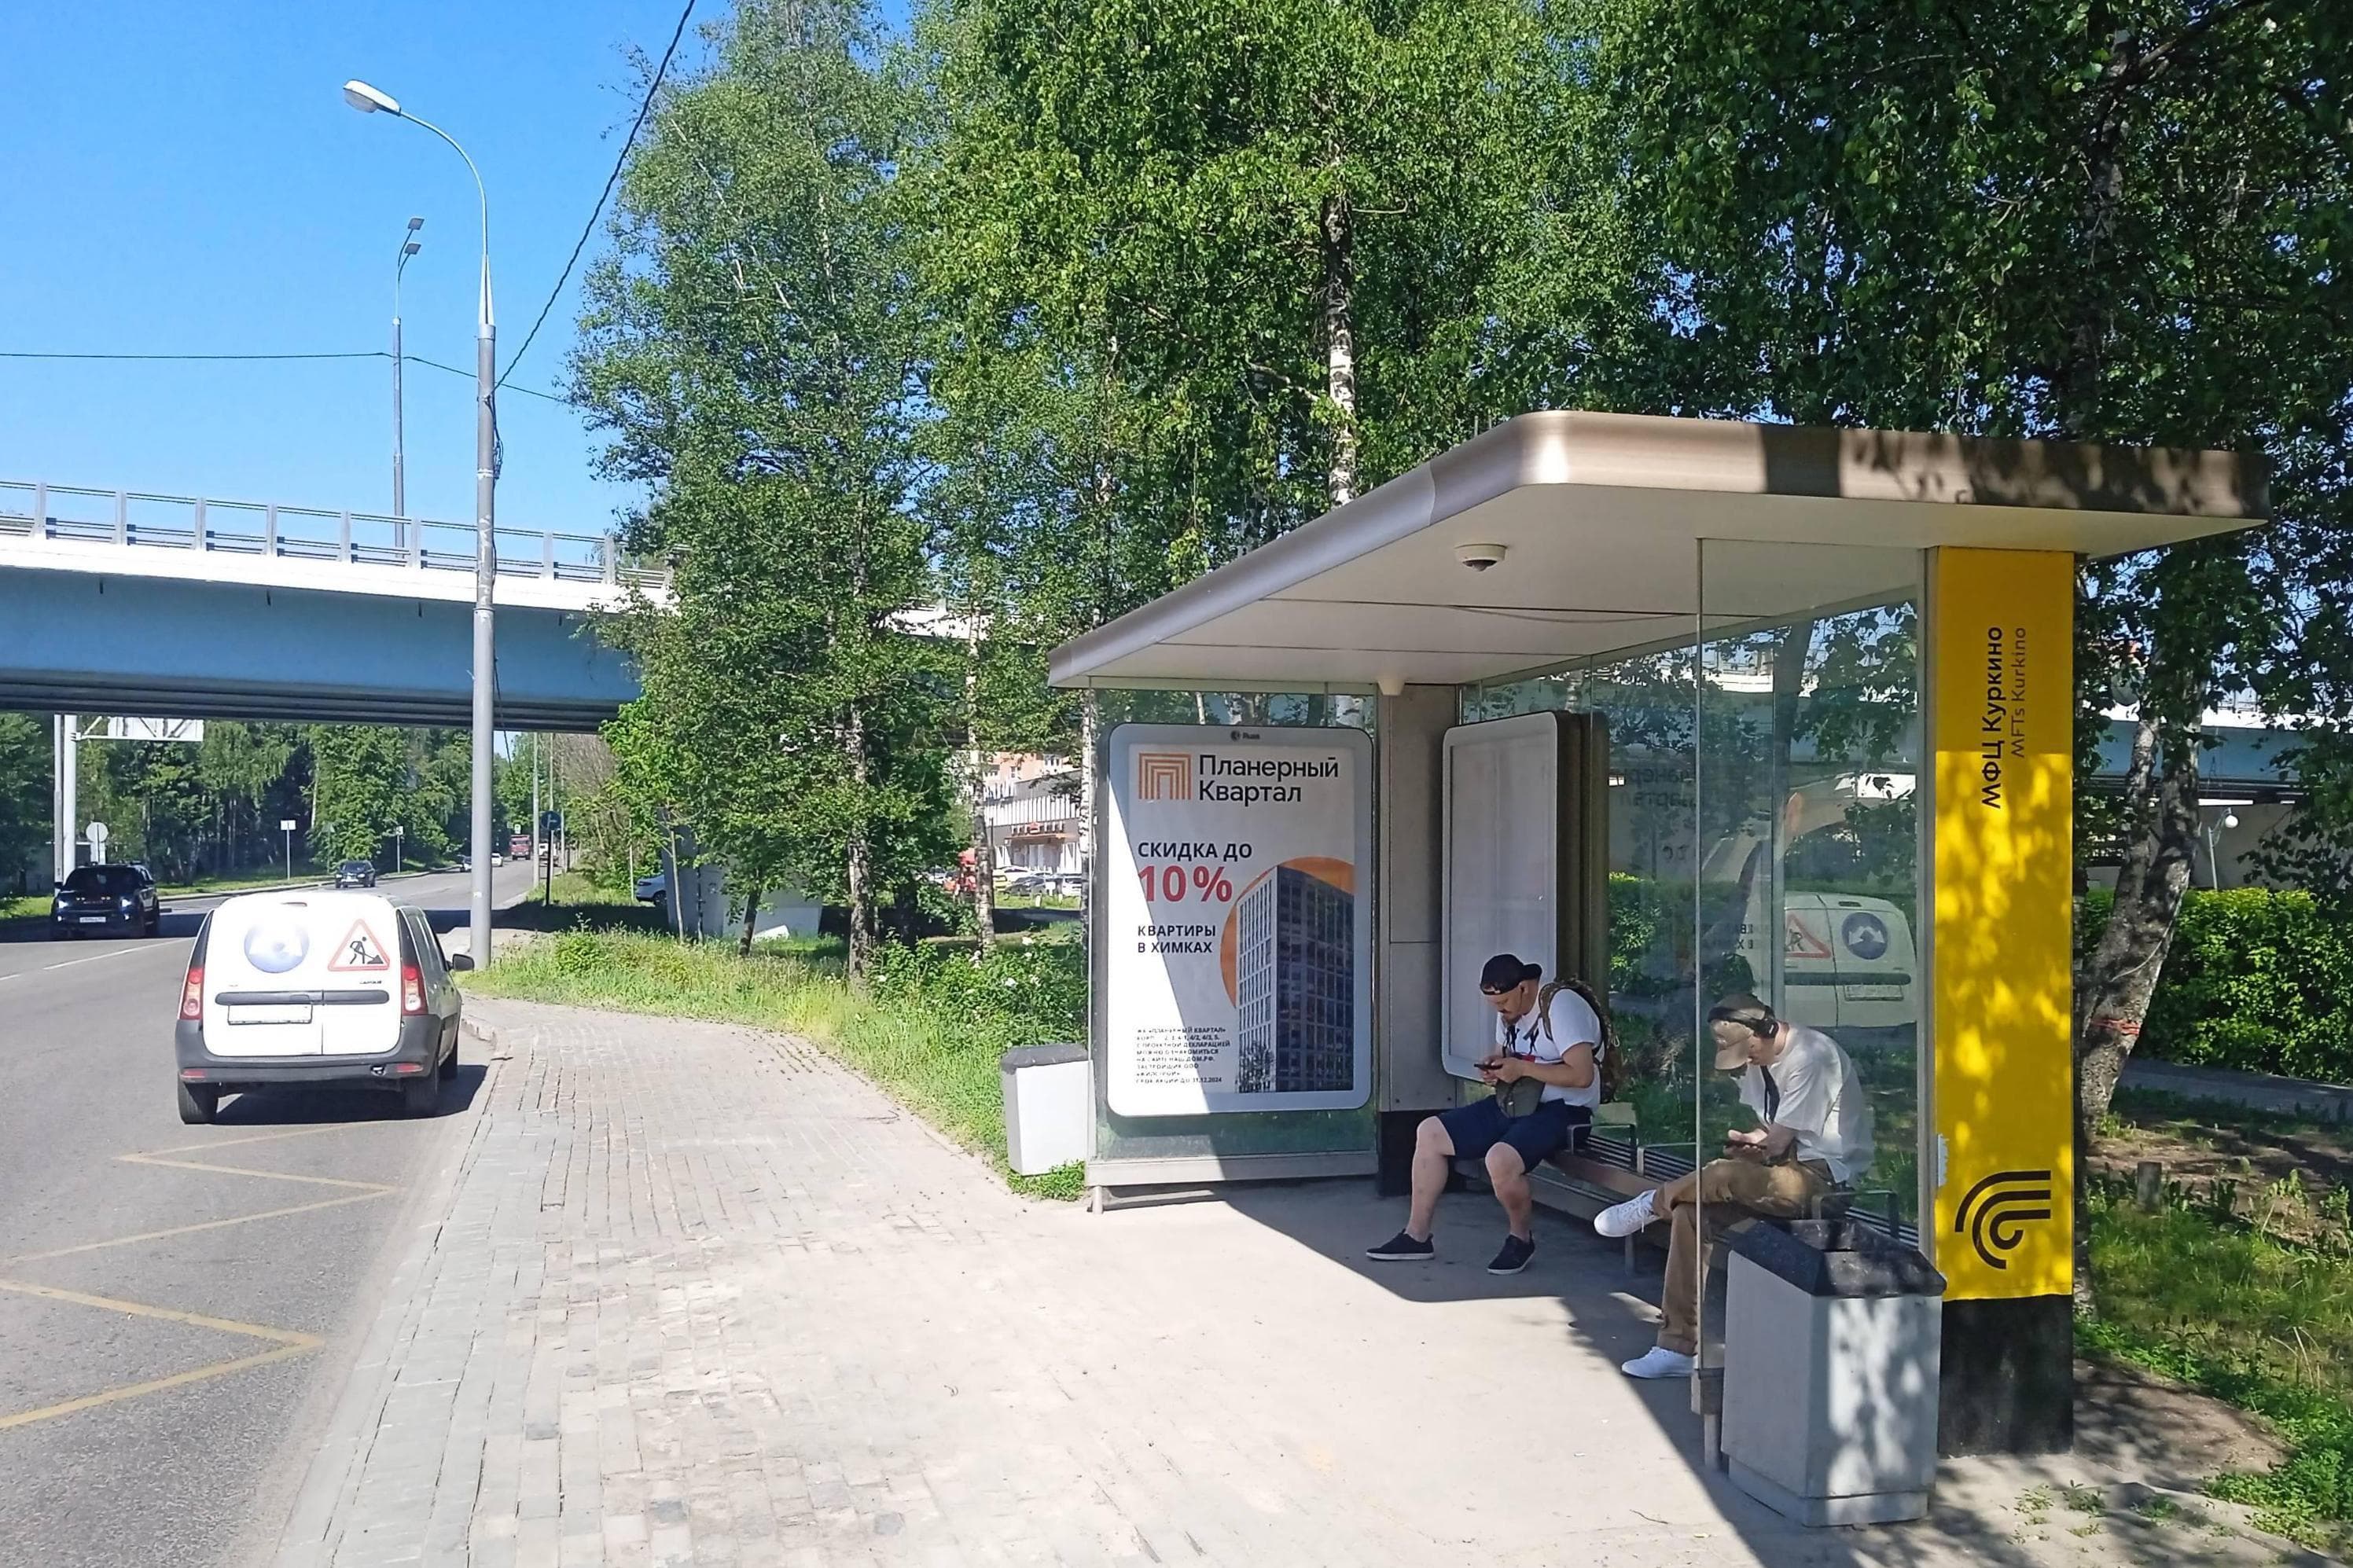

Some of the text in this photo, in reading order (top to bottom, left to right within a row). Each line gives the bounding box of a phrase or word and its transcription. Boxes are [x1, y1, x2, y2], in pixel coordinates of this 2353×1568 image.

[2010, 627, 2026, 758] MFTs Kurkino
[1981, 626, 2007, 809] МФЦ Куркино
[1199, 755, 1338, 782] Планерный
[1199, 780, 1301, 806] Квартал
[1138, 842, 1252, 862] СКИДКА ДО
[1138, 865, 1233, 902] 10%
[1138, 924, 1215, 937] КВАРТИРЫ
[1138, 942, 1212, 953] В ХИМКАХ
